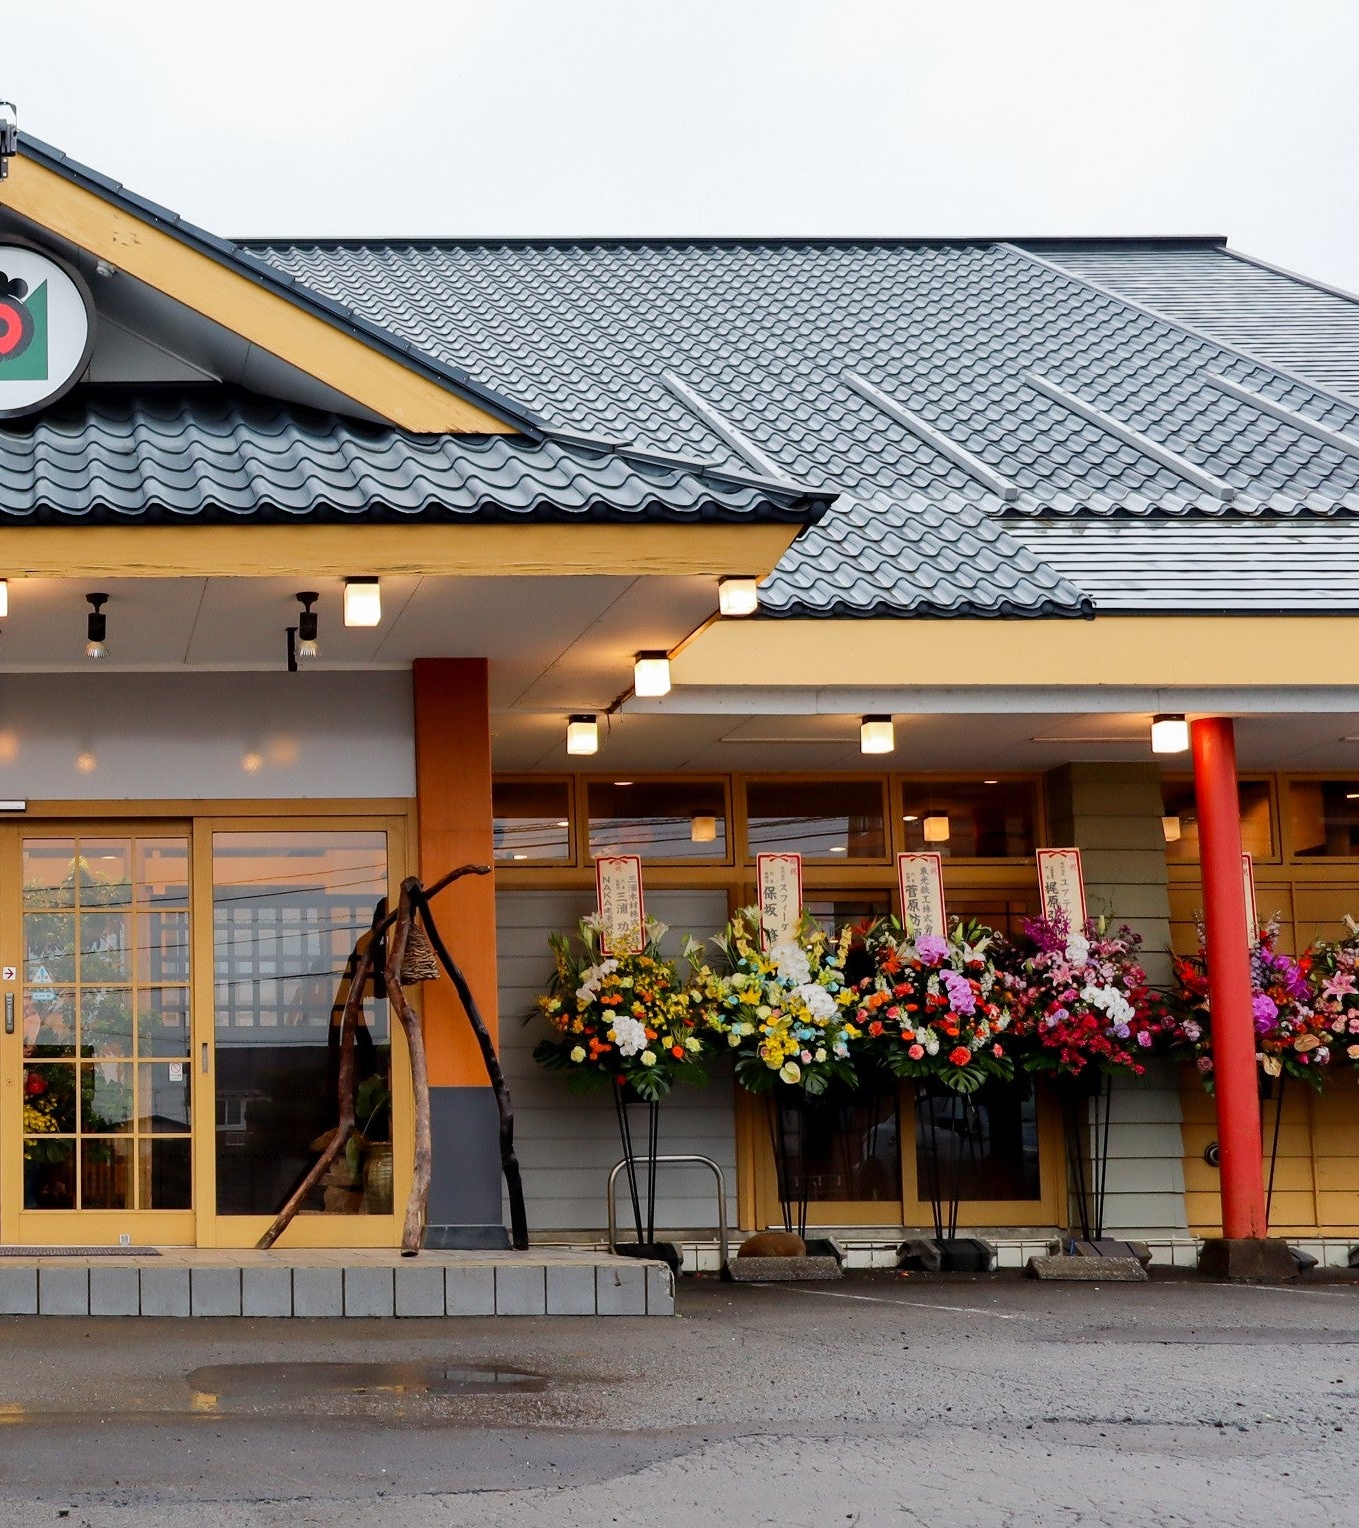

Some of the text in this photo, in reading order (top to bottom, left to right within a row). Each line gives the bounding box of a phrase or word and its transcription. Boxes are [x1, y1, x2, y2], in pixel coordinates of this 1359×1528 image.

[779, 884, 790, 932] スフィーダ
